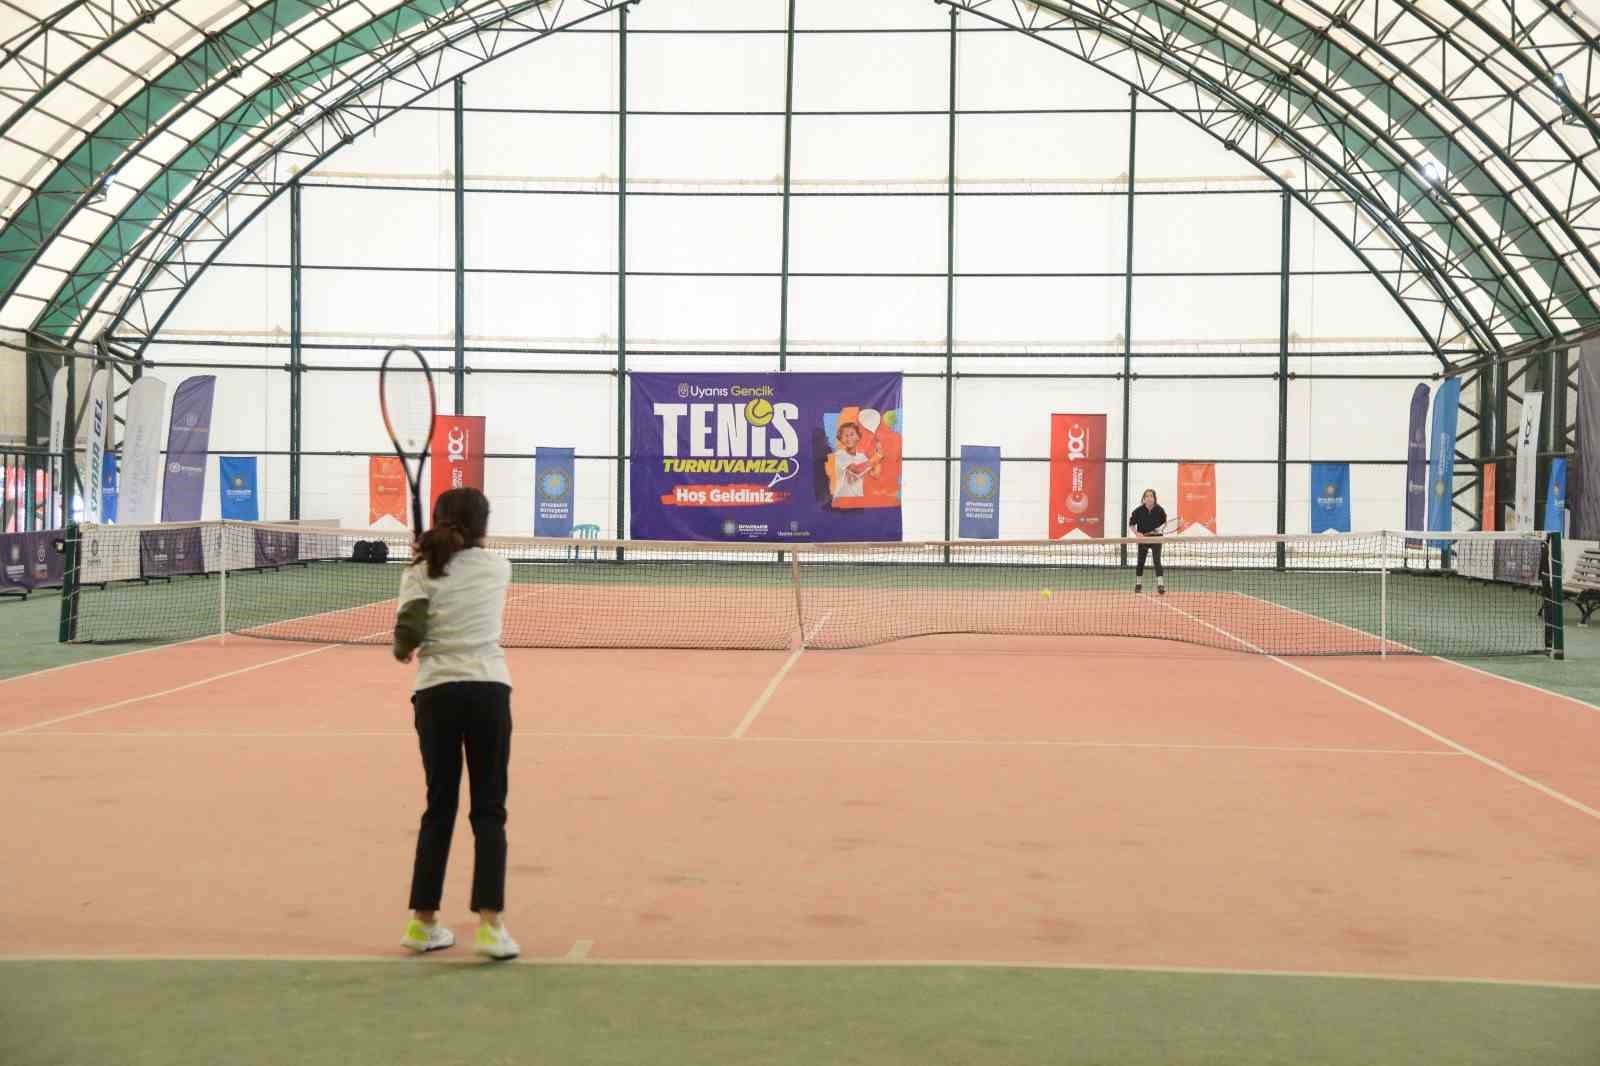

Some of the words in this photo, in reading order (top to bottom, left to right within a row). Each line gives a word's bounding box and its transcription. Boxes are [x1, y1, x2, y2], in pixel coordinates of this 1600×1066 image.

[94, 398, 104, 437] GEL
[663, 459, 789, 474] TURNUVAMIZA
[676, 488, 706, 504] Hoş
[709, 488, 774, 503] Geldiniz
